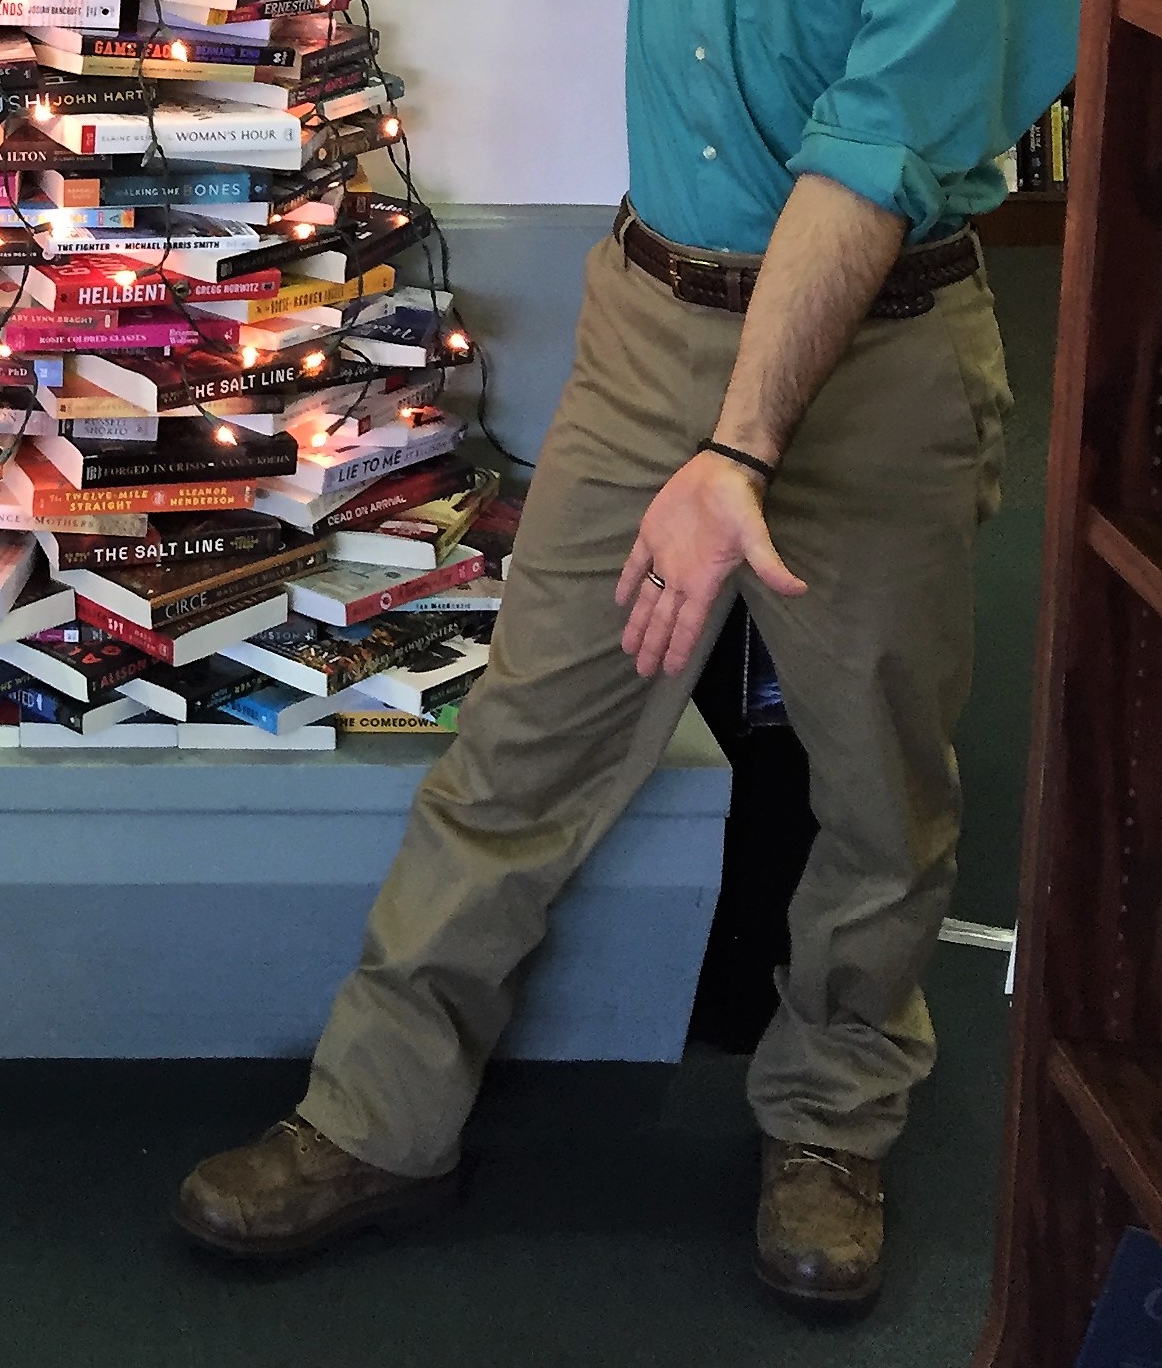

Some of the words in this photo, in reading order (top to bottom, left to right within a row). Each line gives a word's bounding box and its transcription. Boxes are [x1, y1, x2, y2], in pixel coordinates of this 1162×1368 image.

[94, 40, 137, 58] GAME
[54, 92, 97, 107] JOHN
[104, 89, 144, 102] HART
[176, 131, 237, 142] WOMAN'S
[241, 129, 278, 141] HOUR
[57, 243, 74, 252] THE
[76, 242, 110, 252] FIGHTER
[125, 241, 162, 251] MICHAEL
[193, 241, 220, 250] SMITH
[195, 286, 221, 296] GREGG
[223, 282, 259, 294] HURWITZ
[40, 335, 65, 344] ROSIE
[66, 335, 107, 345] COLORED
[8, 366, 28, 377] PhD
[220, 374, 256, 394] SALT
[261, 367, 294, 387] LINE
[339, 463, 358, 483] LIE
[362, 458, 379, 476] TO
[382, 449, 402, 467] ME
[179, 486, 227, 497] ELEANOR
[70, 500, 132, 512] STRAIGHT
[170, 495, 235, 507] HENDERSON
[327, 509, 354, 527] DEAD
[354, 506, 370, 520] ON
[370, 494, 408, 514] ARRIVAL
[94, 546, 129, 564] THE
[135, 542, 178, 560] SALT
[185, 538, 225, 554] LINE
[164, 591, 208, 620] CIRCE
